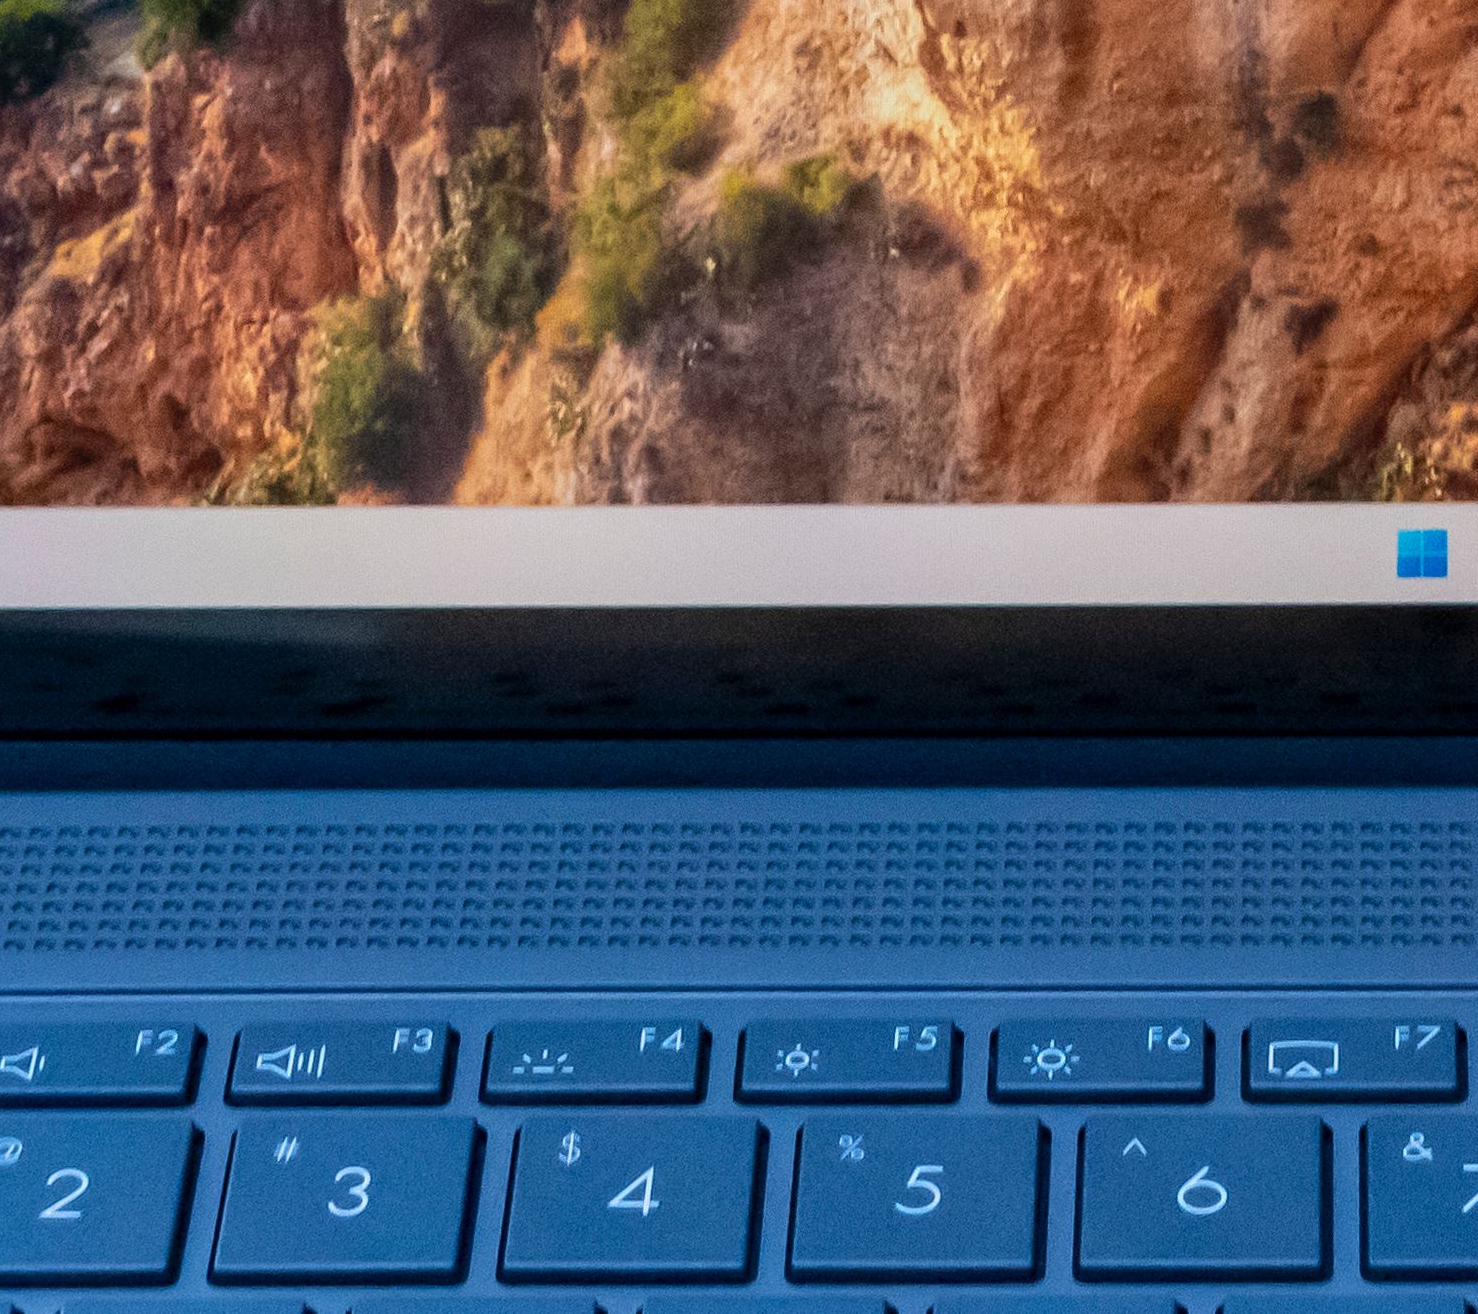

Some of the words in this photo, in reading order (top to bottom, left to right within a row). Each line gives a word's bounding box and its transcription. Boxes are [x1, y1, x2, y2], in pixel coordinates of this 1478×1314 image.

[134, 1029, 179, 1055] F2
[392, 1028, 434, 1053] F3
[639, 1027, 683, 1052] F4
[893, 1026, 938, 1051] F5
[1147, 1026, 1191, 1051] F6
[1394, 1025, 1441, 1050] F7
[558, 1131, 581, 1166] $
[838, 1134, 866, 1161] %
[1402, 1132, 1433, 1161] &
[39, 1168, 89, 1219] 2
[327, 1166, 372, 1217] 3
[608, 1167, 659, 1216] 4
[894, 1164, 944, 1215] 5
[1176, 1165, 1228, 1215] 6
